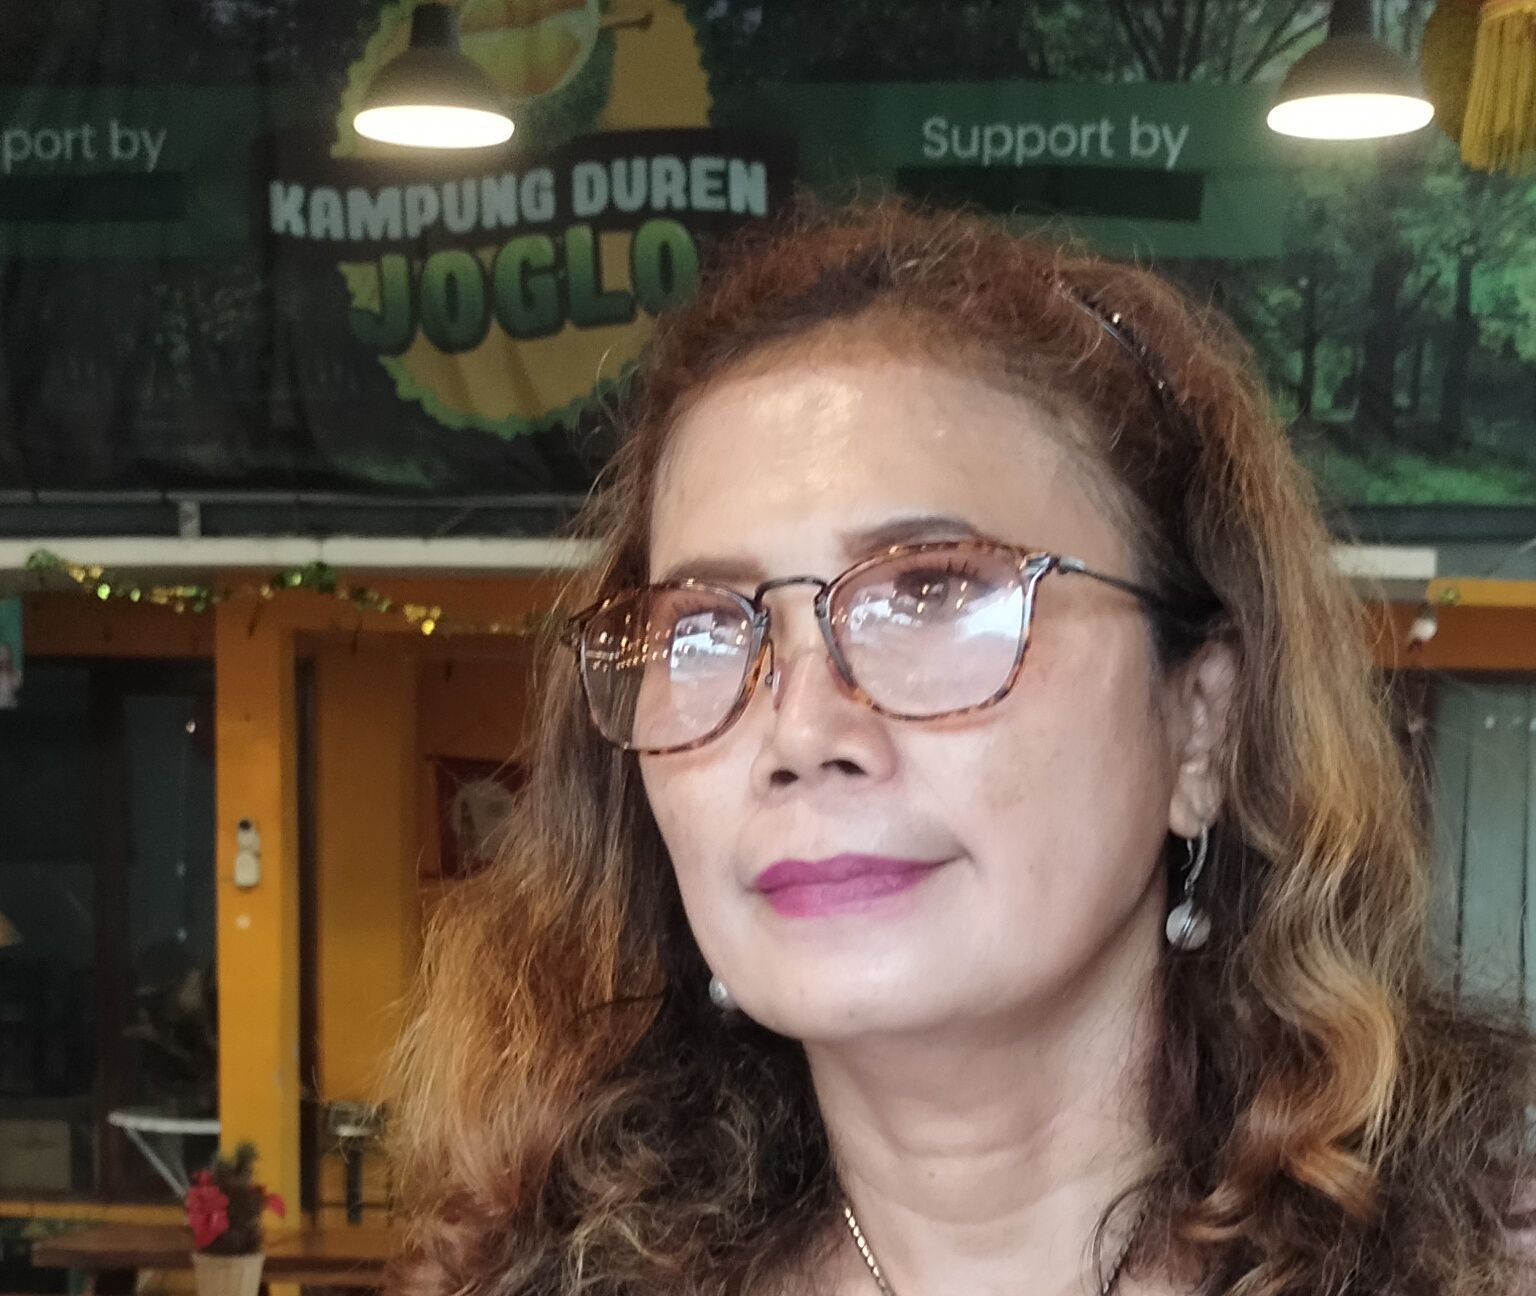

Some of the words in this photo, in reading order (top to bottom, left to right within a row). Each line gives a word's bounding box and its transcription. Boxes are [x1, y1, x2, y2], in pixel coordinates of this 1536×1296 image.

[110, 117, 168, 173] by
[921, 115, 1115, 168] Support
[1129, 115, 1191, 172] by
[268, 166, 557, 242] KAMPUNG
[571, 154, 768, 218] DUREN
[348, 217, 701, 358] JOGLO
